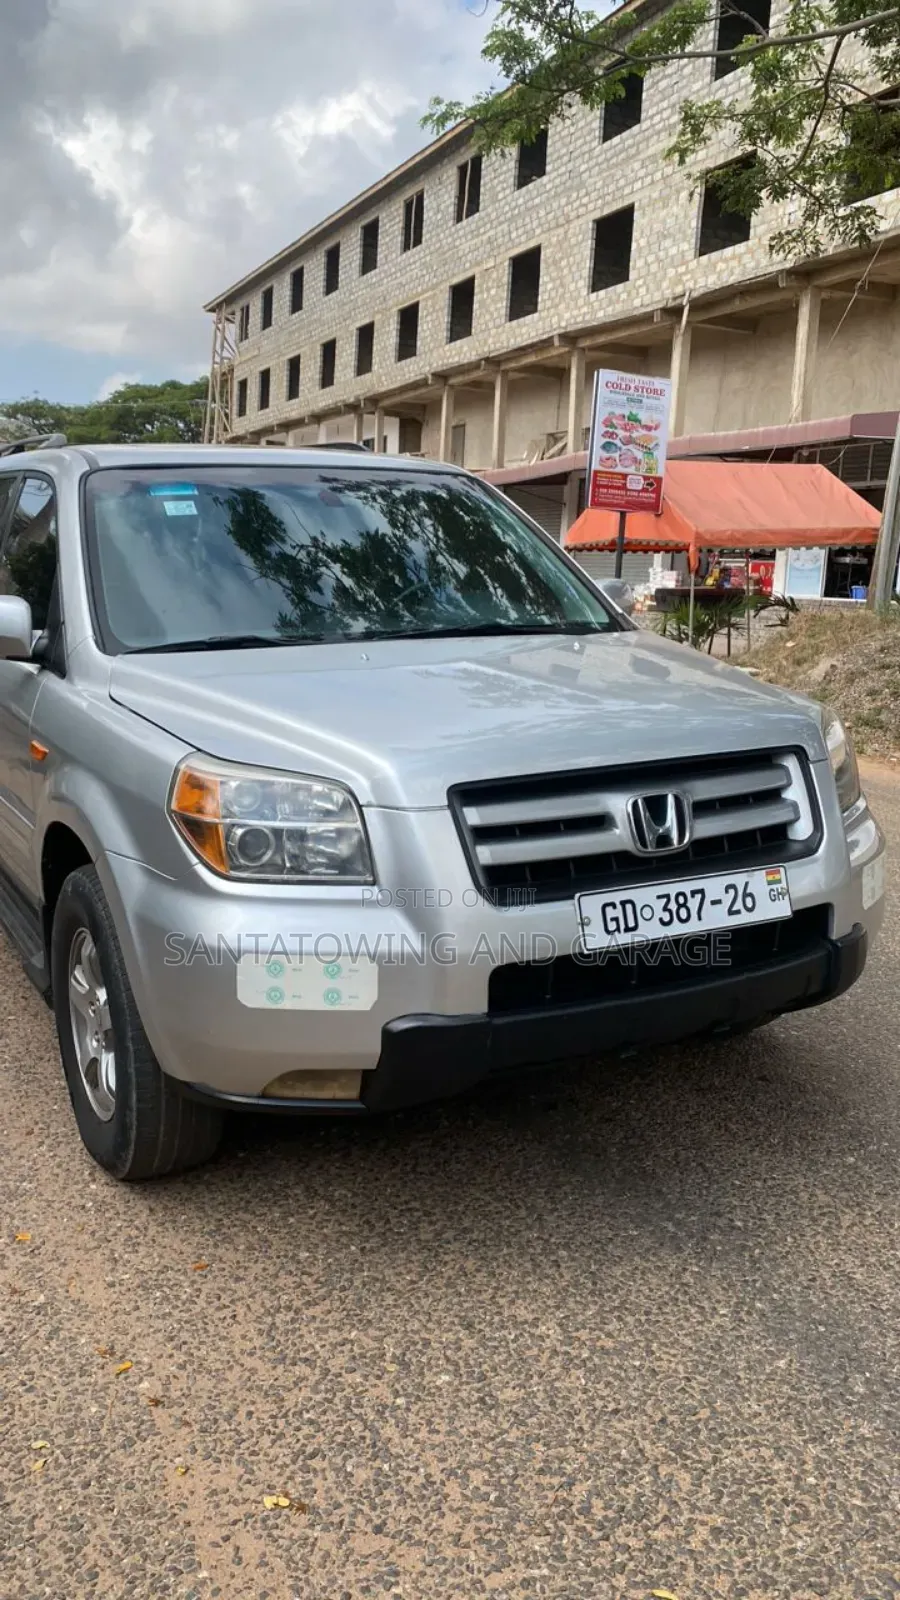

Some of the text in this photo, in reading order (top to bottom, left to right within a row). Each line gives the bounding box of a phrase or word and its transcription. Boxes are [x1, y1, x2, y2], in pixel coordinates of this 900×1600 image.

[605, 380, 666, 396] COLD STORE
[600, 880, 757, 936] GD 387-26
